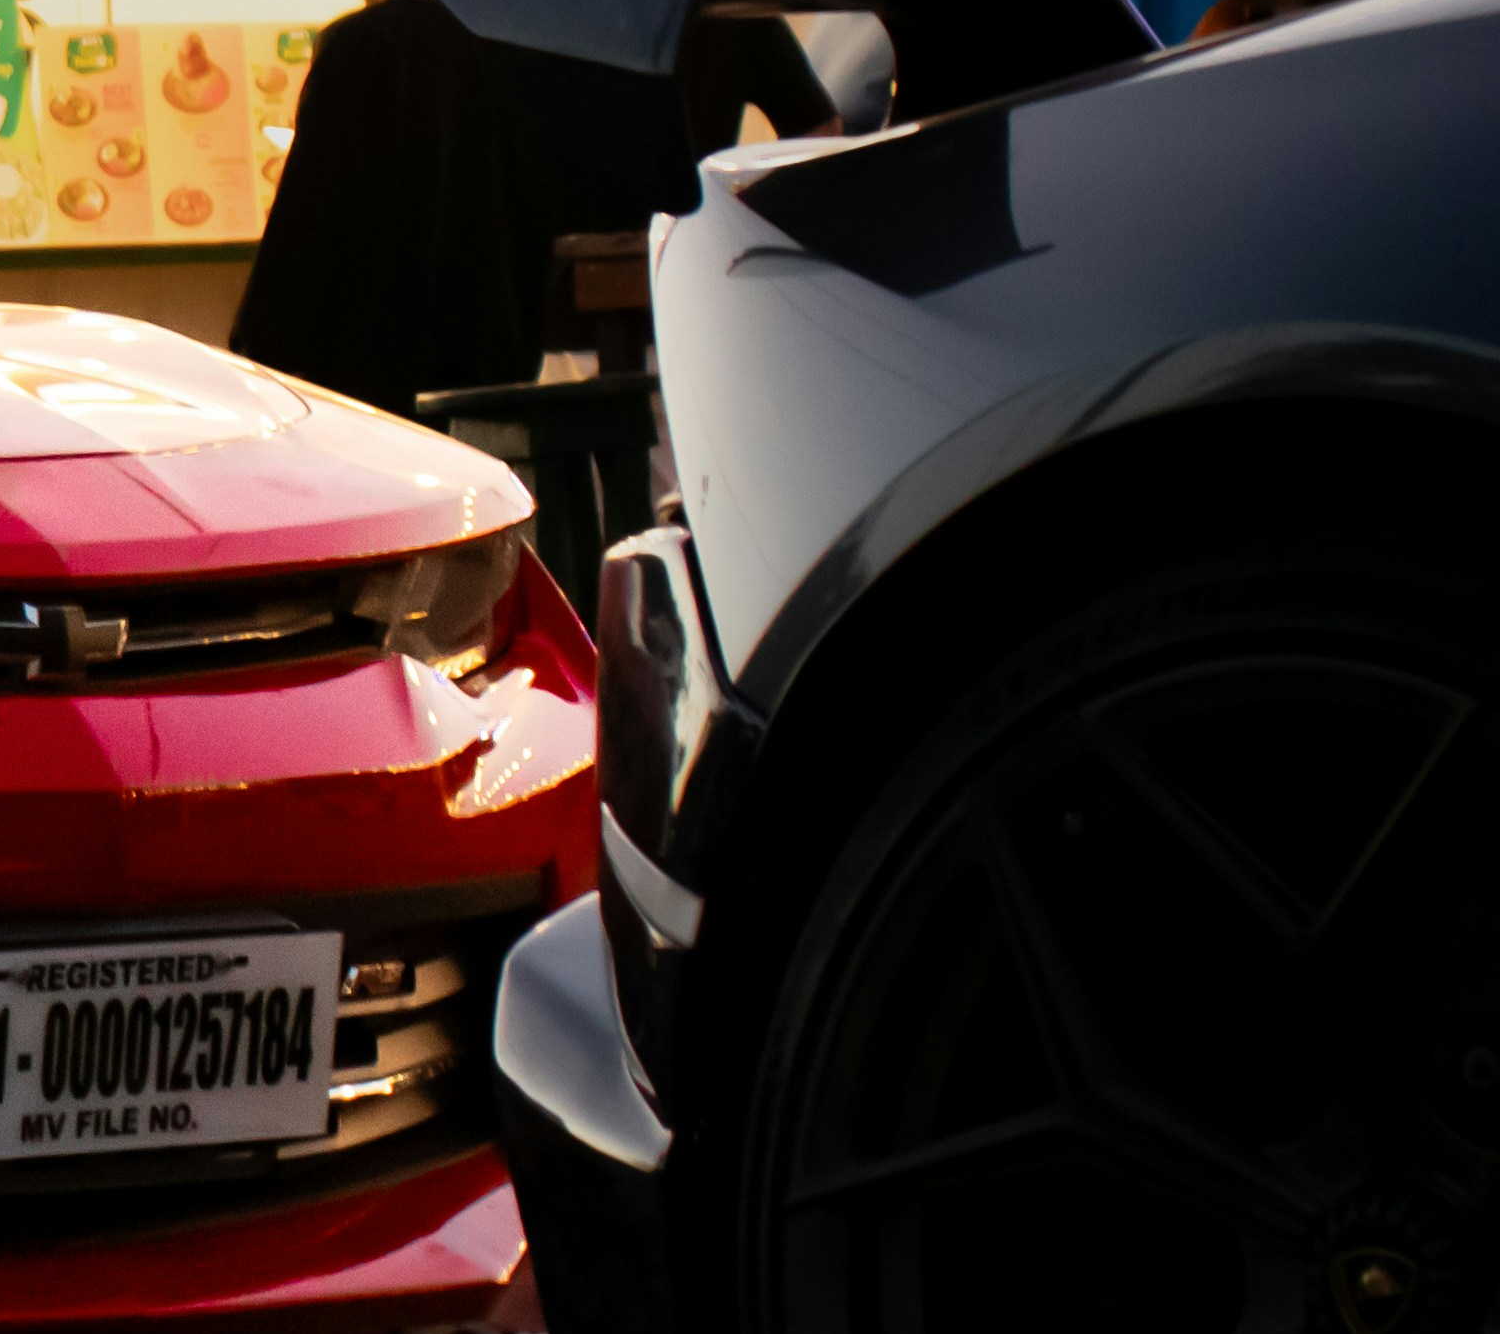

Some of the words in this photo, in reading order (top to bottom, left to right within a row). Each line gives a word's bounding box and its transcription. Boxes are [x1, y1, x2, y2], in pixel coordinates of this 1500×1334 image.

[26, 954, 217, 994] REGISTERED
[21, 1113, 64, 1143] MV
[76, 1107, 138, 1138] FILE
[149, 1103, 197, 1133] NO.
